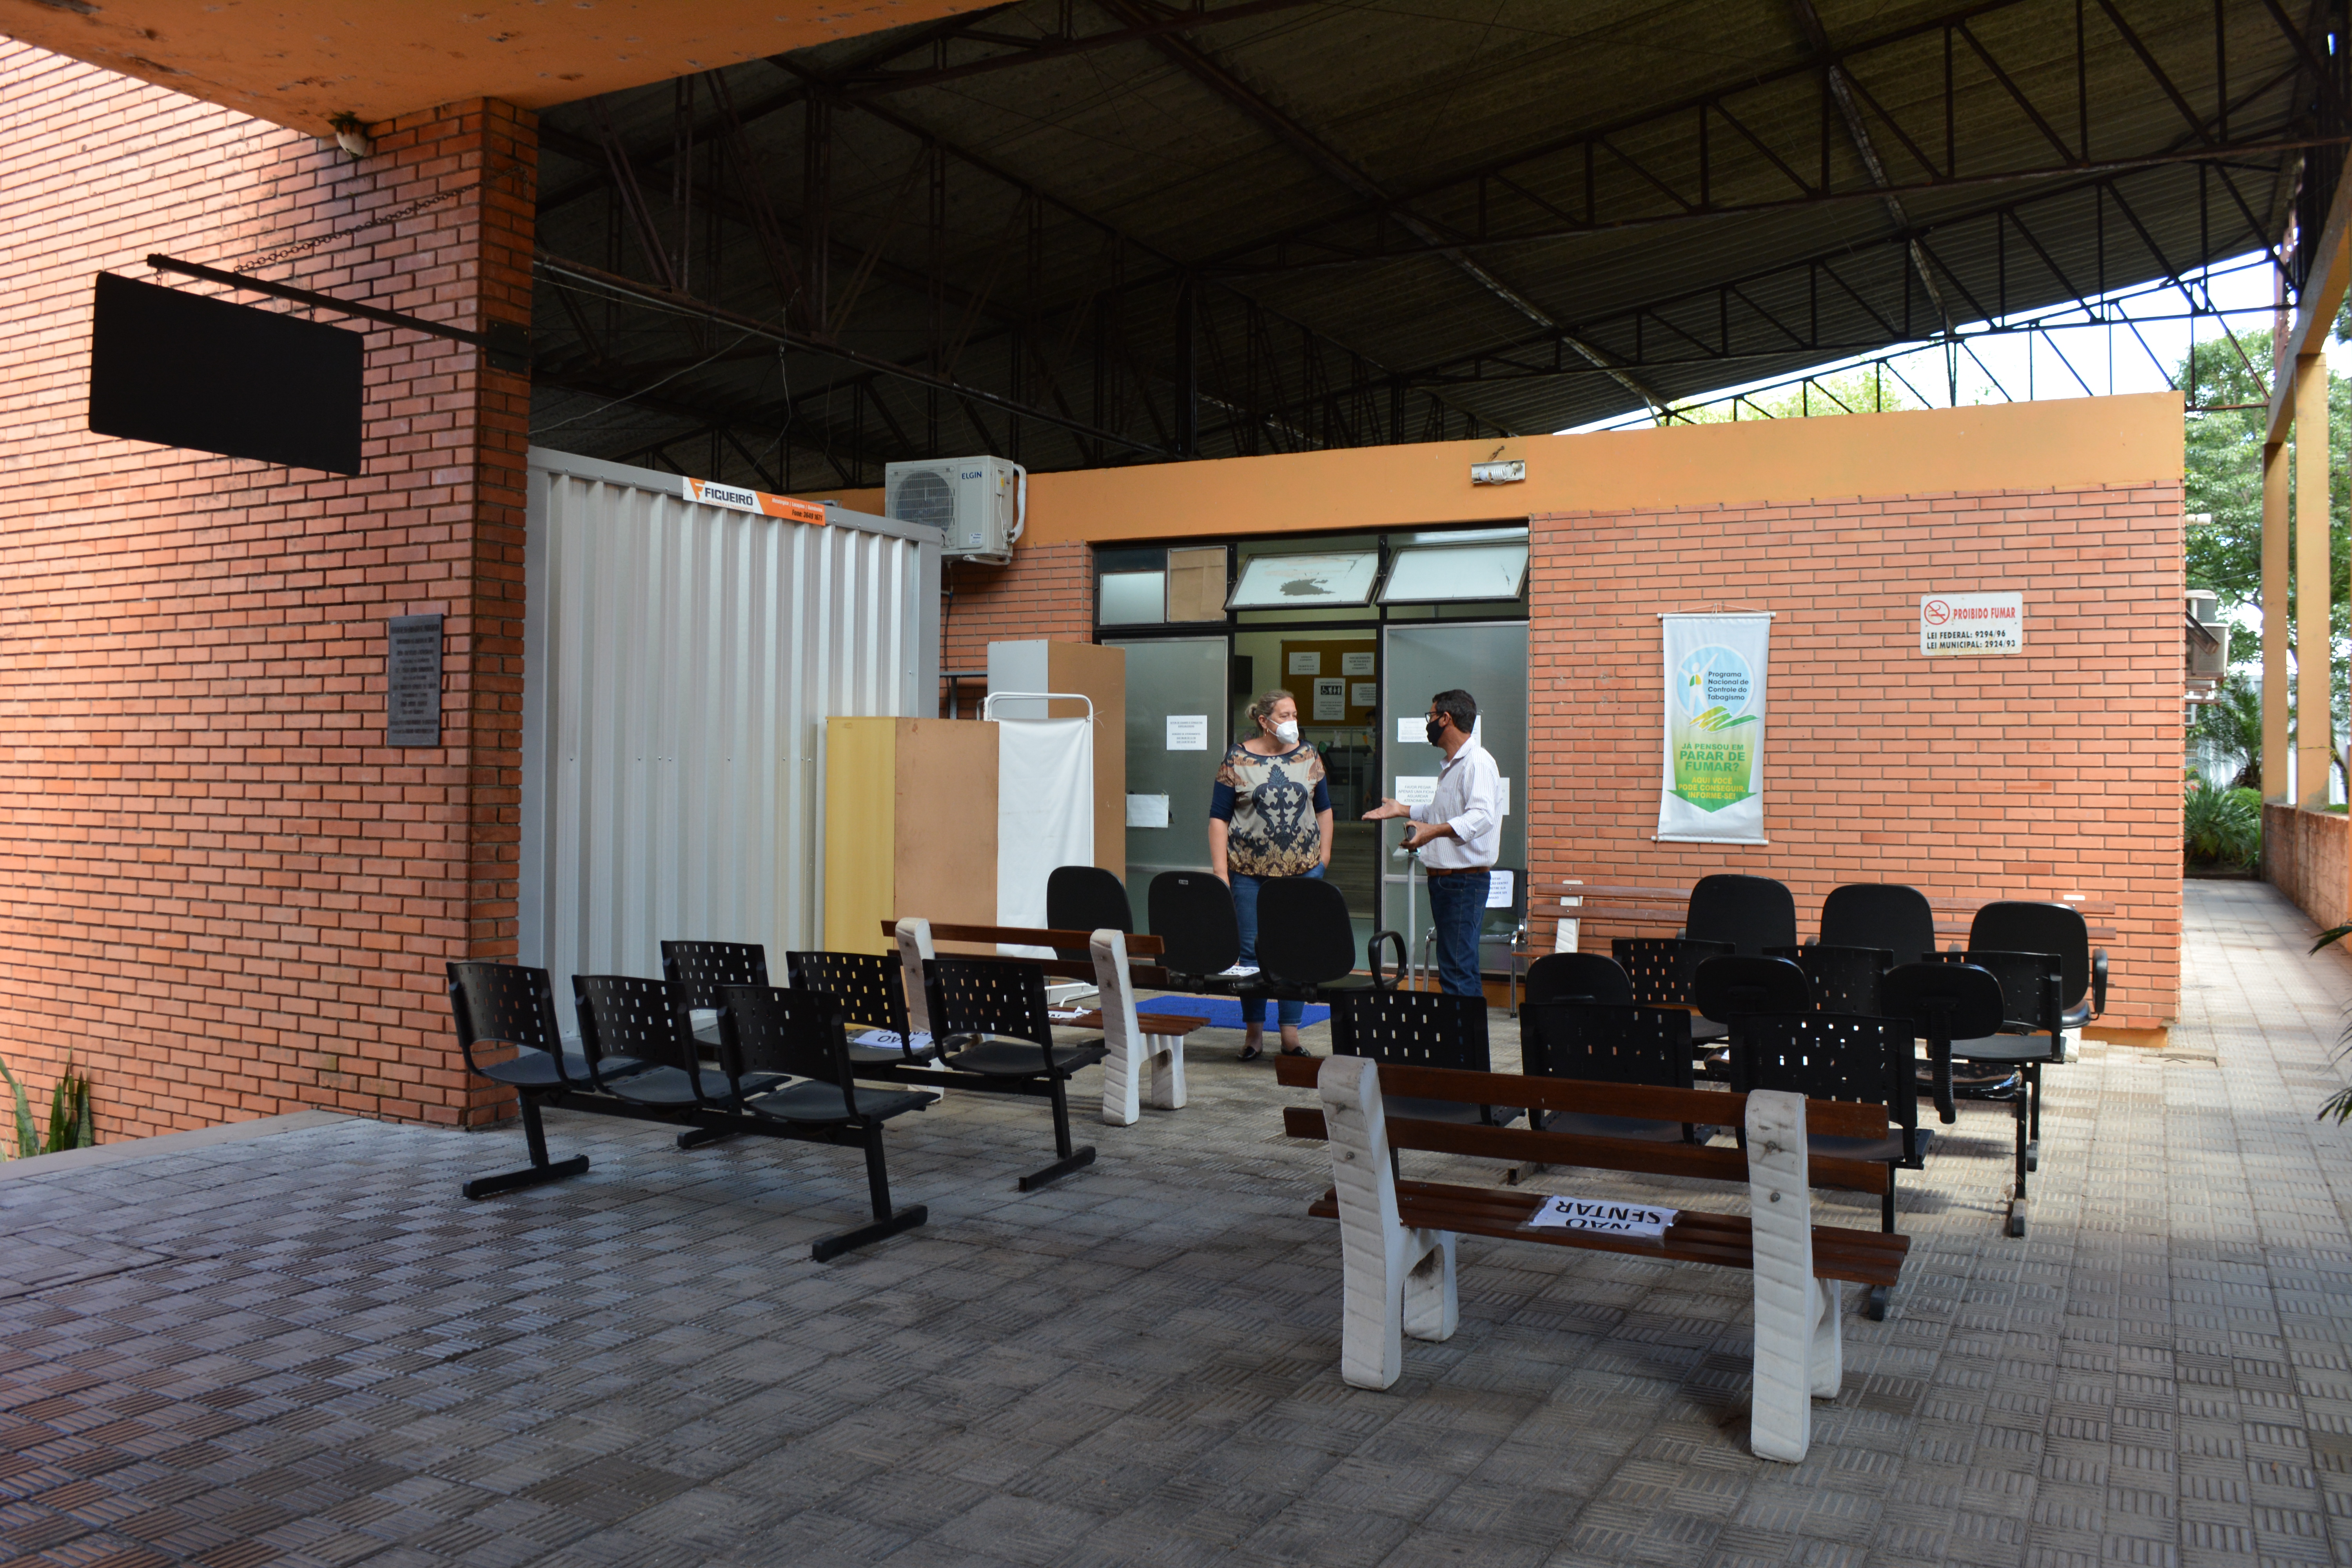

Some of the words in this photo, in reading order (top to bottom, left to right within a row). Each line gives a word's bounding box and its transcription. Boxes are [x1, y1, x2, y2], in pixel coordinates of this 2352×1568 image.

[962, 471, 982, 479] ELGIN
[705, 487, 753, 506] FIGUEIRÓ
[1954, 608, 1988, 619] PROIBIDO
[1991, 607, 2015, 618] FUMAR
[1940, 641, 1982, 649] MUNICIPAL:
[1680, 751, 1724, 760] PARAR
[1728, 752, 1745, 761] DE
[1686, 761, 1740, 771] FUMAR?
[1713, 776, 1733, 784] VOCÊ
[1555, 1201, 1663, 1224] SENTAR
